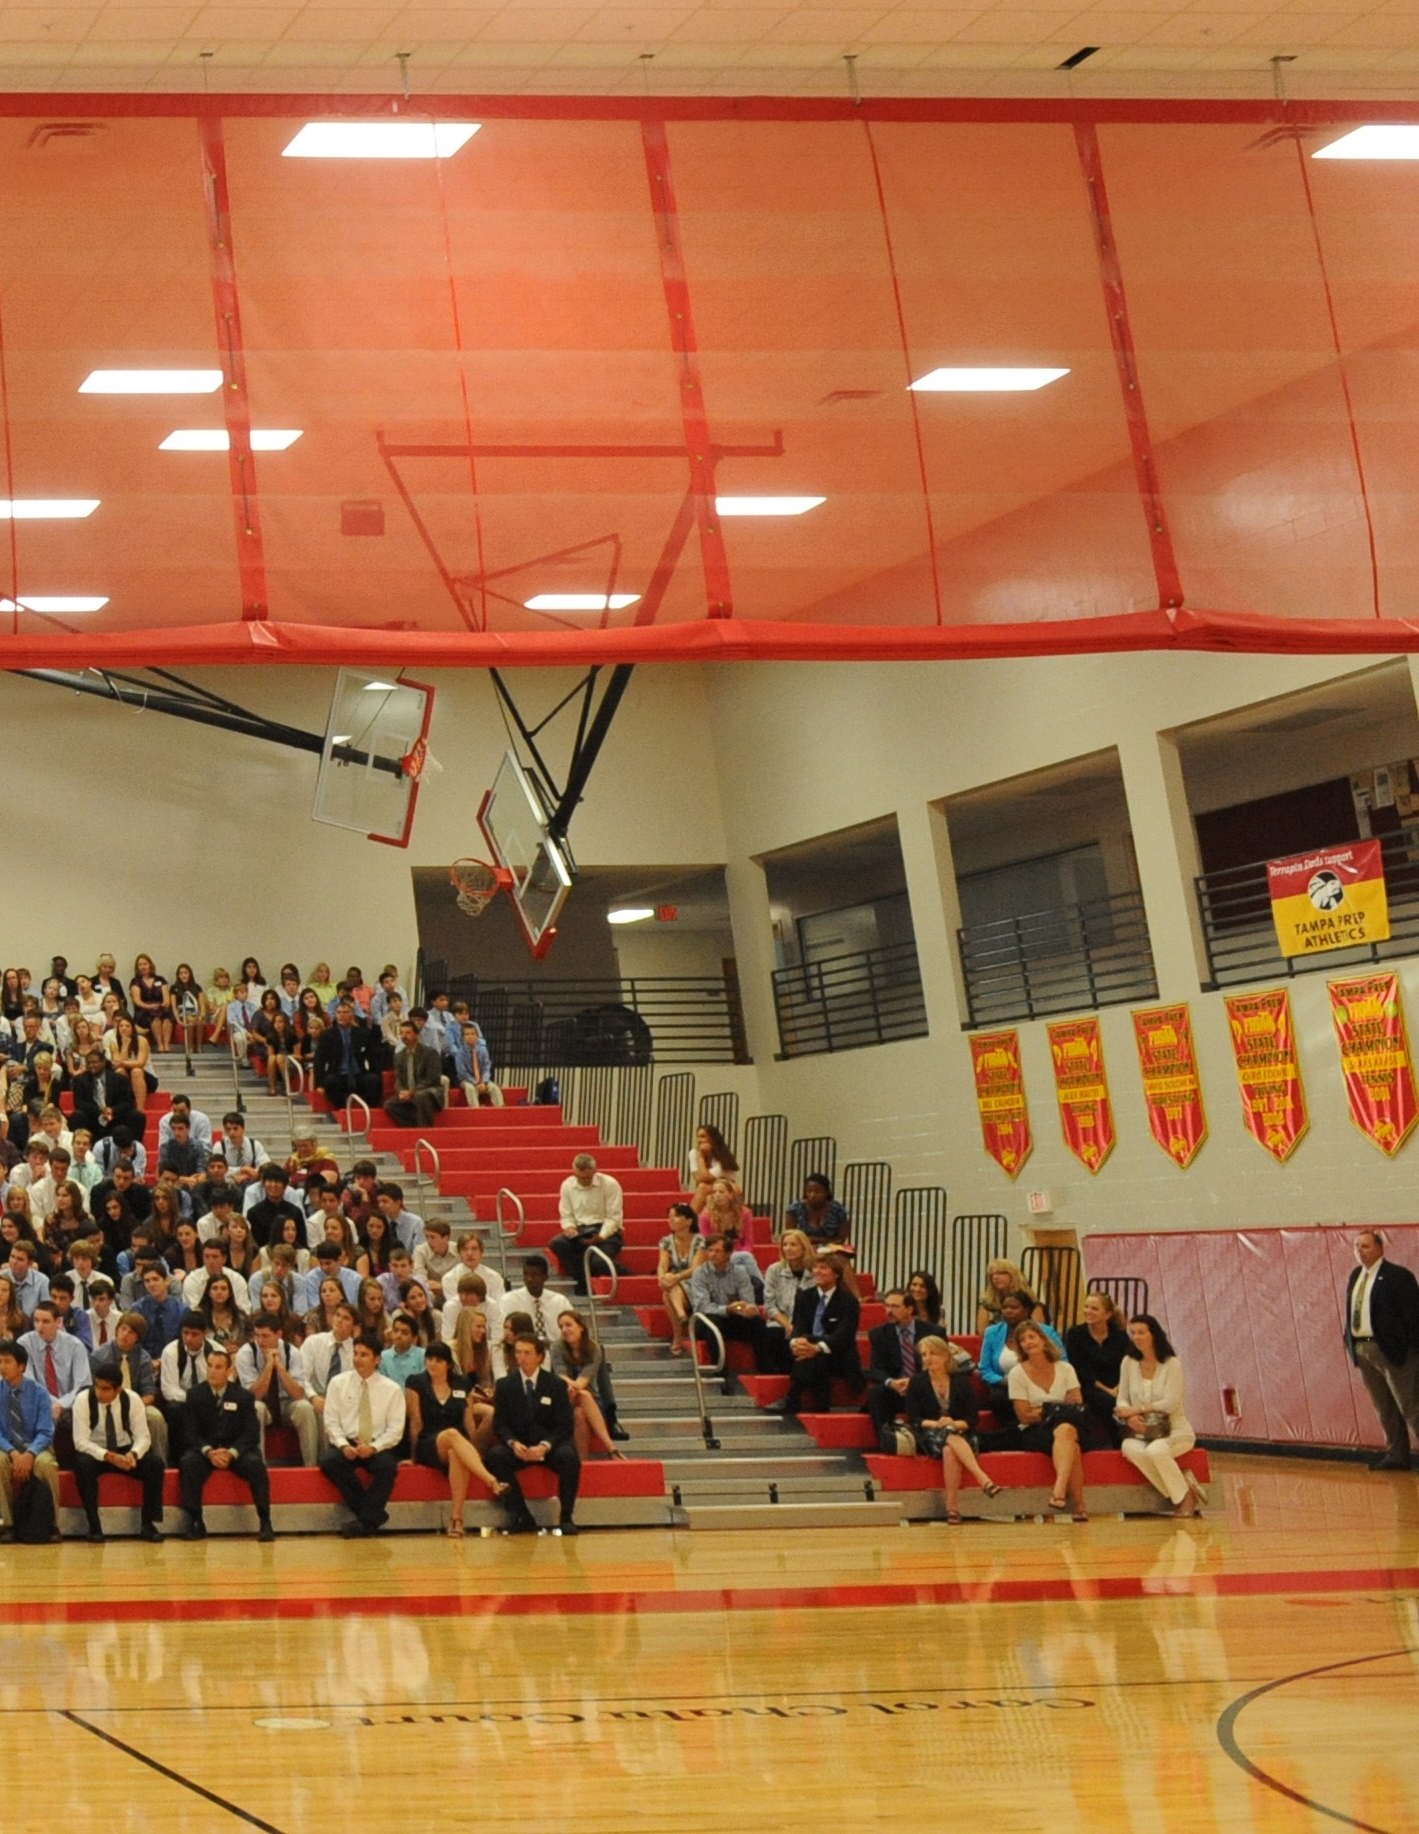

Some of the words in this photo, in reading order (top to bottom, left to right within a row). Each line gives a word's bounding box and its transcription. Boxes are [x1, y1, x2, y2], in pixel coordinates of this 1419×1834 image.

[1295, 917, 1336, 935] TAMPA
[1337, 911, 1366, 927] PREP
[1305, 928, 1366, 949] ATHLETICS
[1353, 1022, 1384, 1037] STATE
[868, 1697, 1095, 1715] Carol
[359, 1711, 585, 1726] Court
